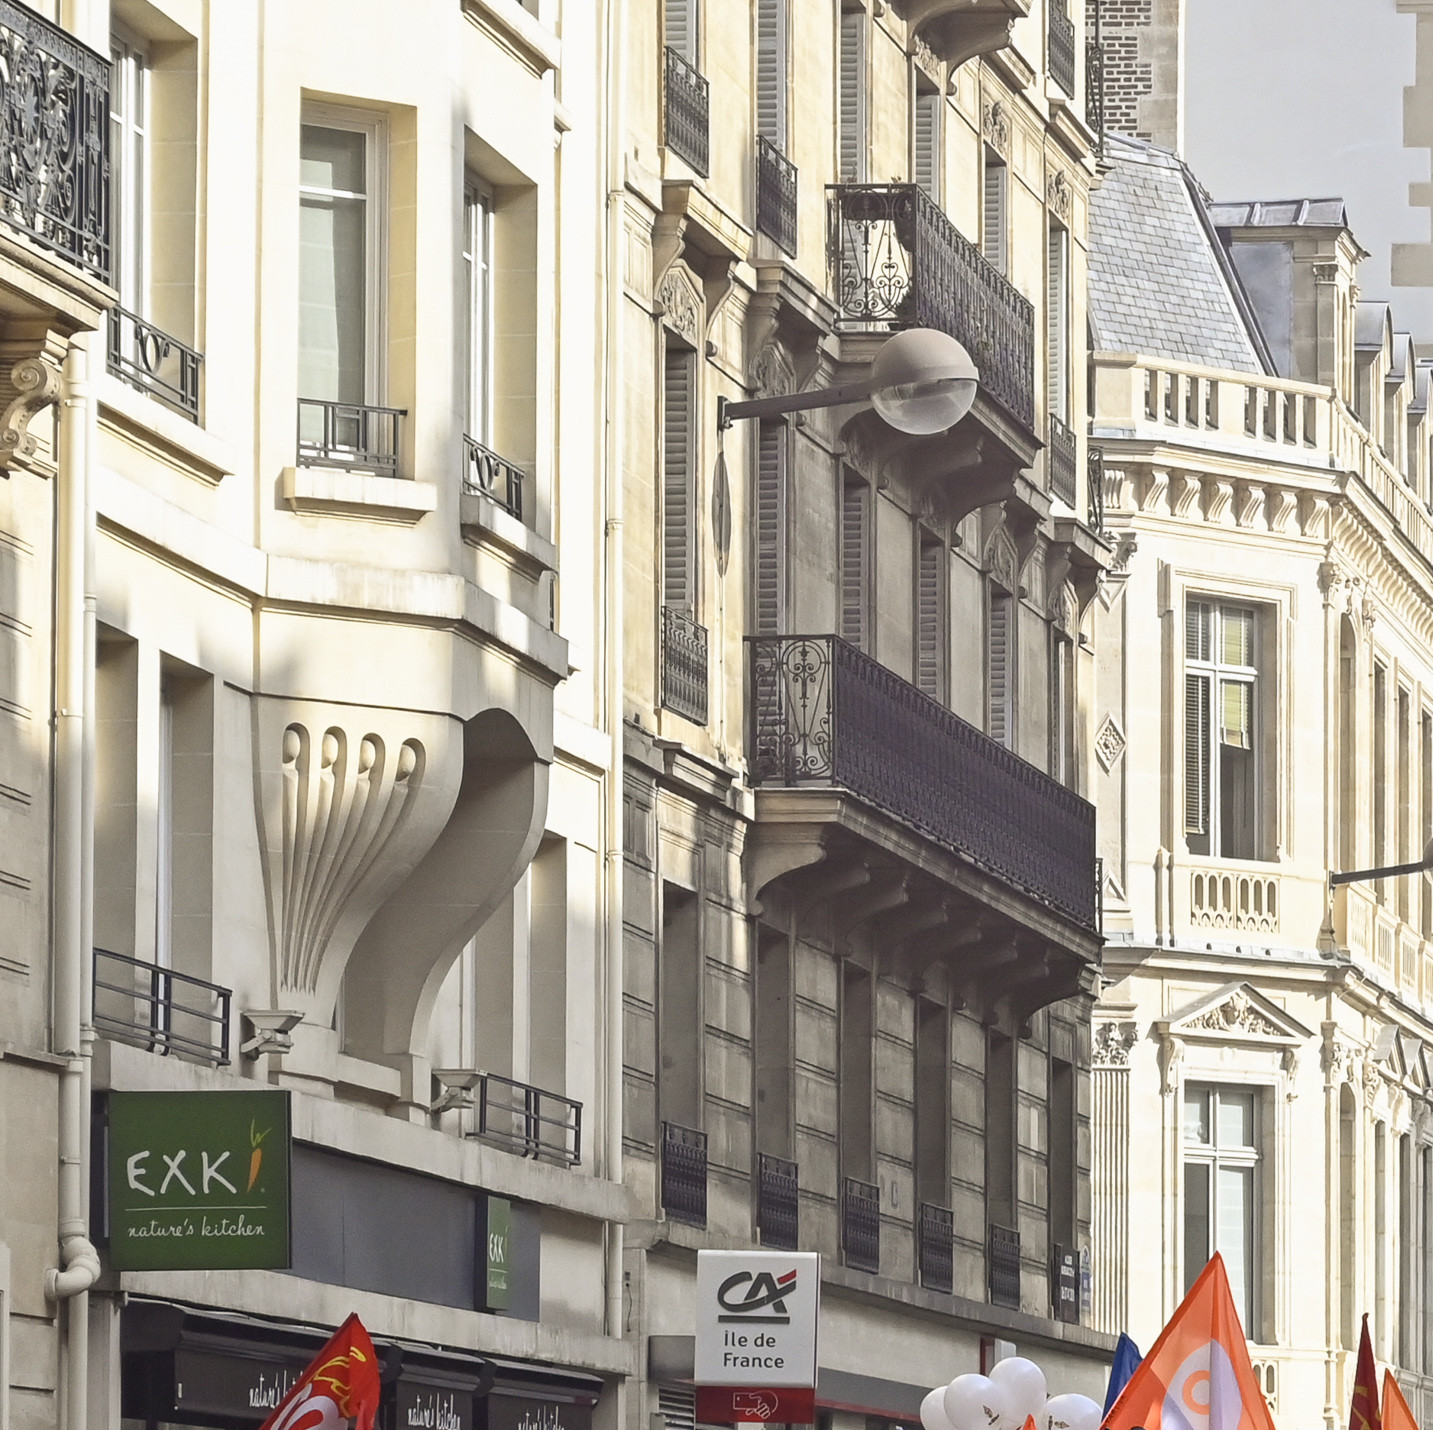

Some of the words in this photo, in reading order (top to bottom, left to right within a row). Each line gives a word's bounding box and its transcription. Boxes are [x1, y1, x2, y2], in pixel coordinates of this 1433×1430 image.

[128, 1218, 194, 1237] nature's
[201, 1214, 265, 1237] kitchen
[717, 1269, 797, 1313] CA
[754, 1333, 776, 1348] de
[723, 1352, 785, 1368] France
